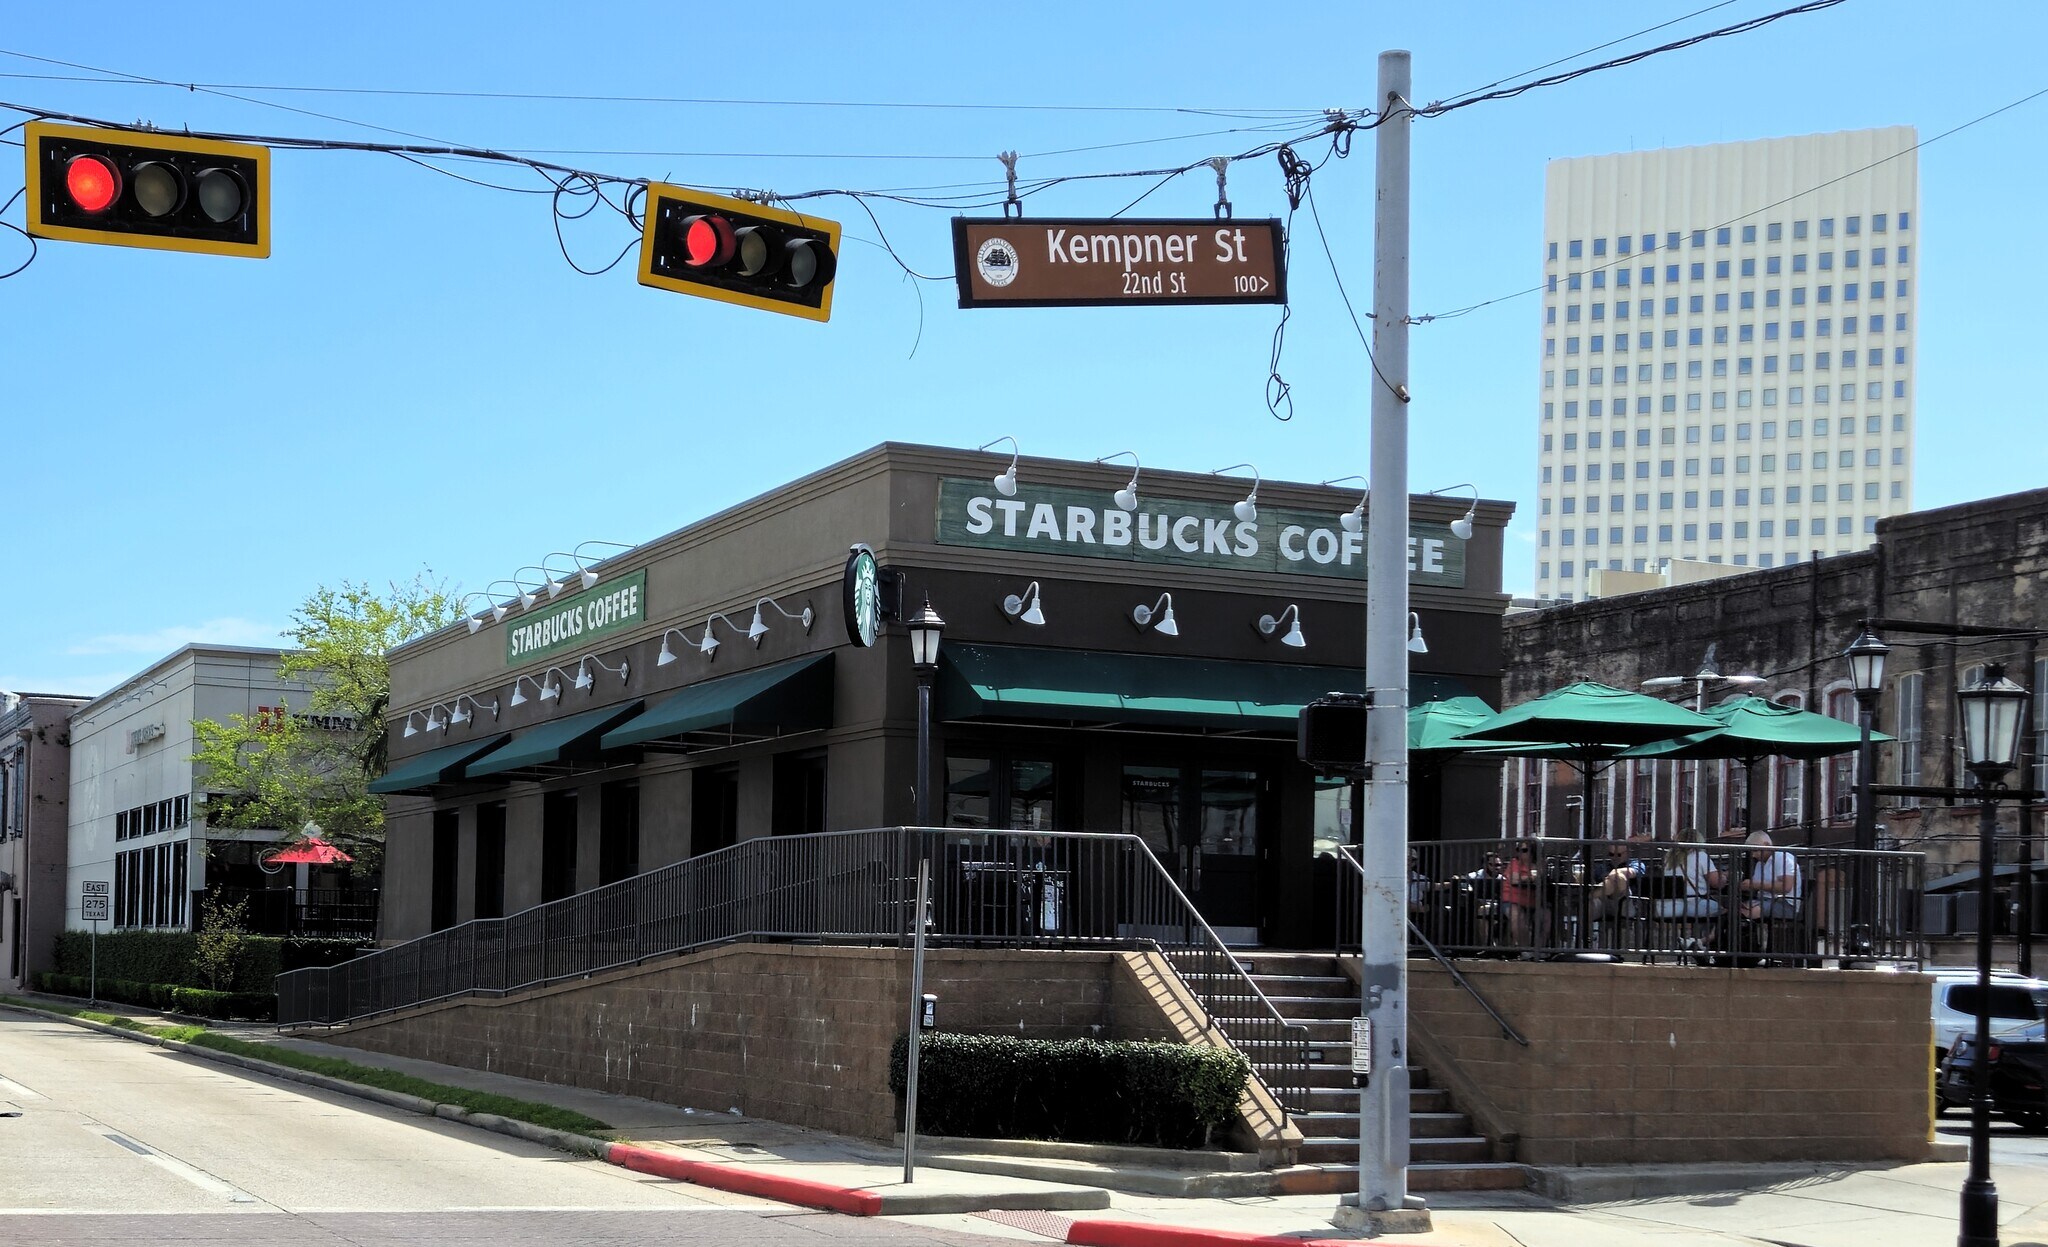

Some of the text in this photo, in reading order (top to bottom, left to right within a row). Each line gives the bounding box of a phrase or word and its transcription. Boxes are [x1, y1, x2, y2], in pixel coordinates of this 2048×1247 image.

[1047, 228, 1248, 272] Kempner St
[1122, 271, 1187, 294] 22nd St
[966, 496, 1444, 573] STARBUCKS COFE
[511, 585, 638, 656] STARBUCKS COFFEE
[86, 883, 106, 892] EAST
[86, 900, 105, 909] 275
